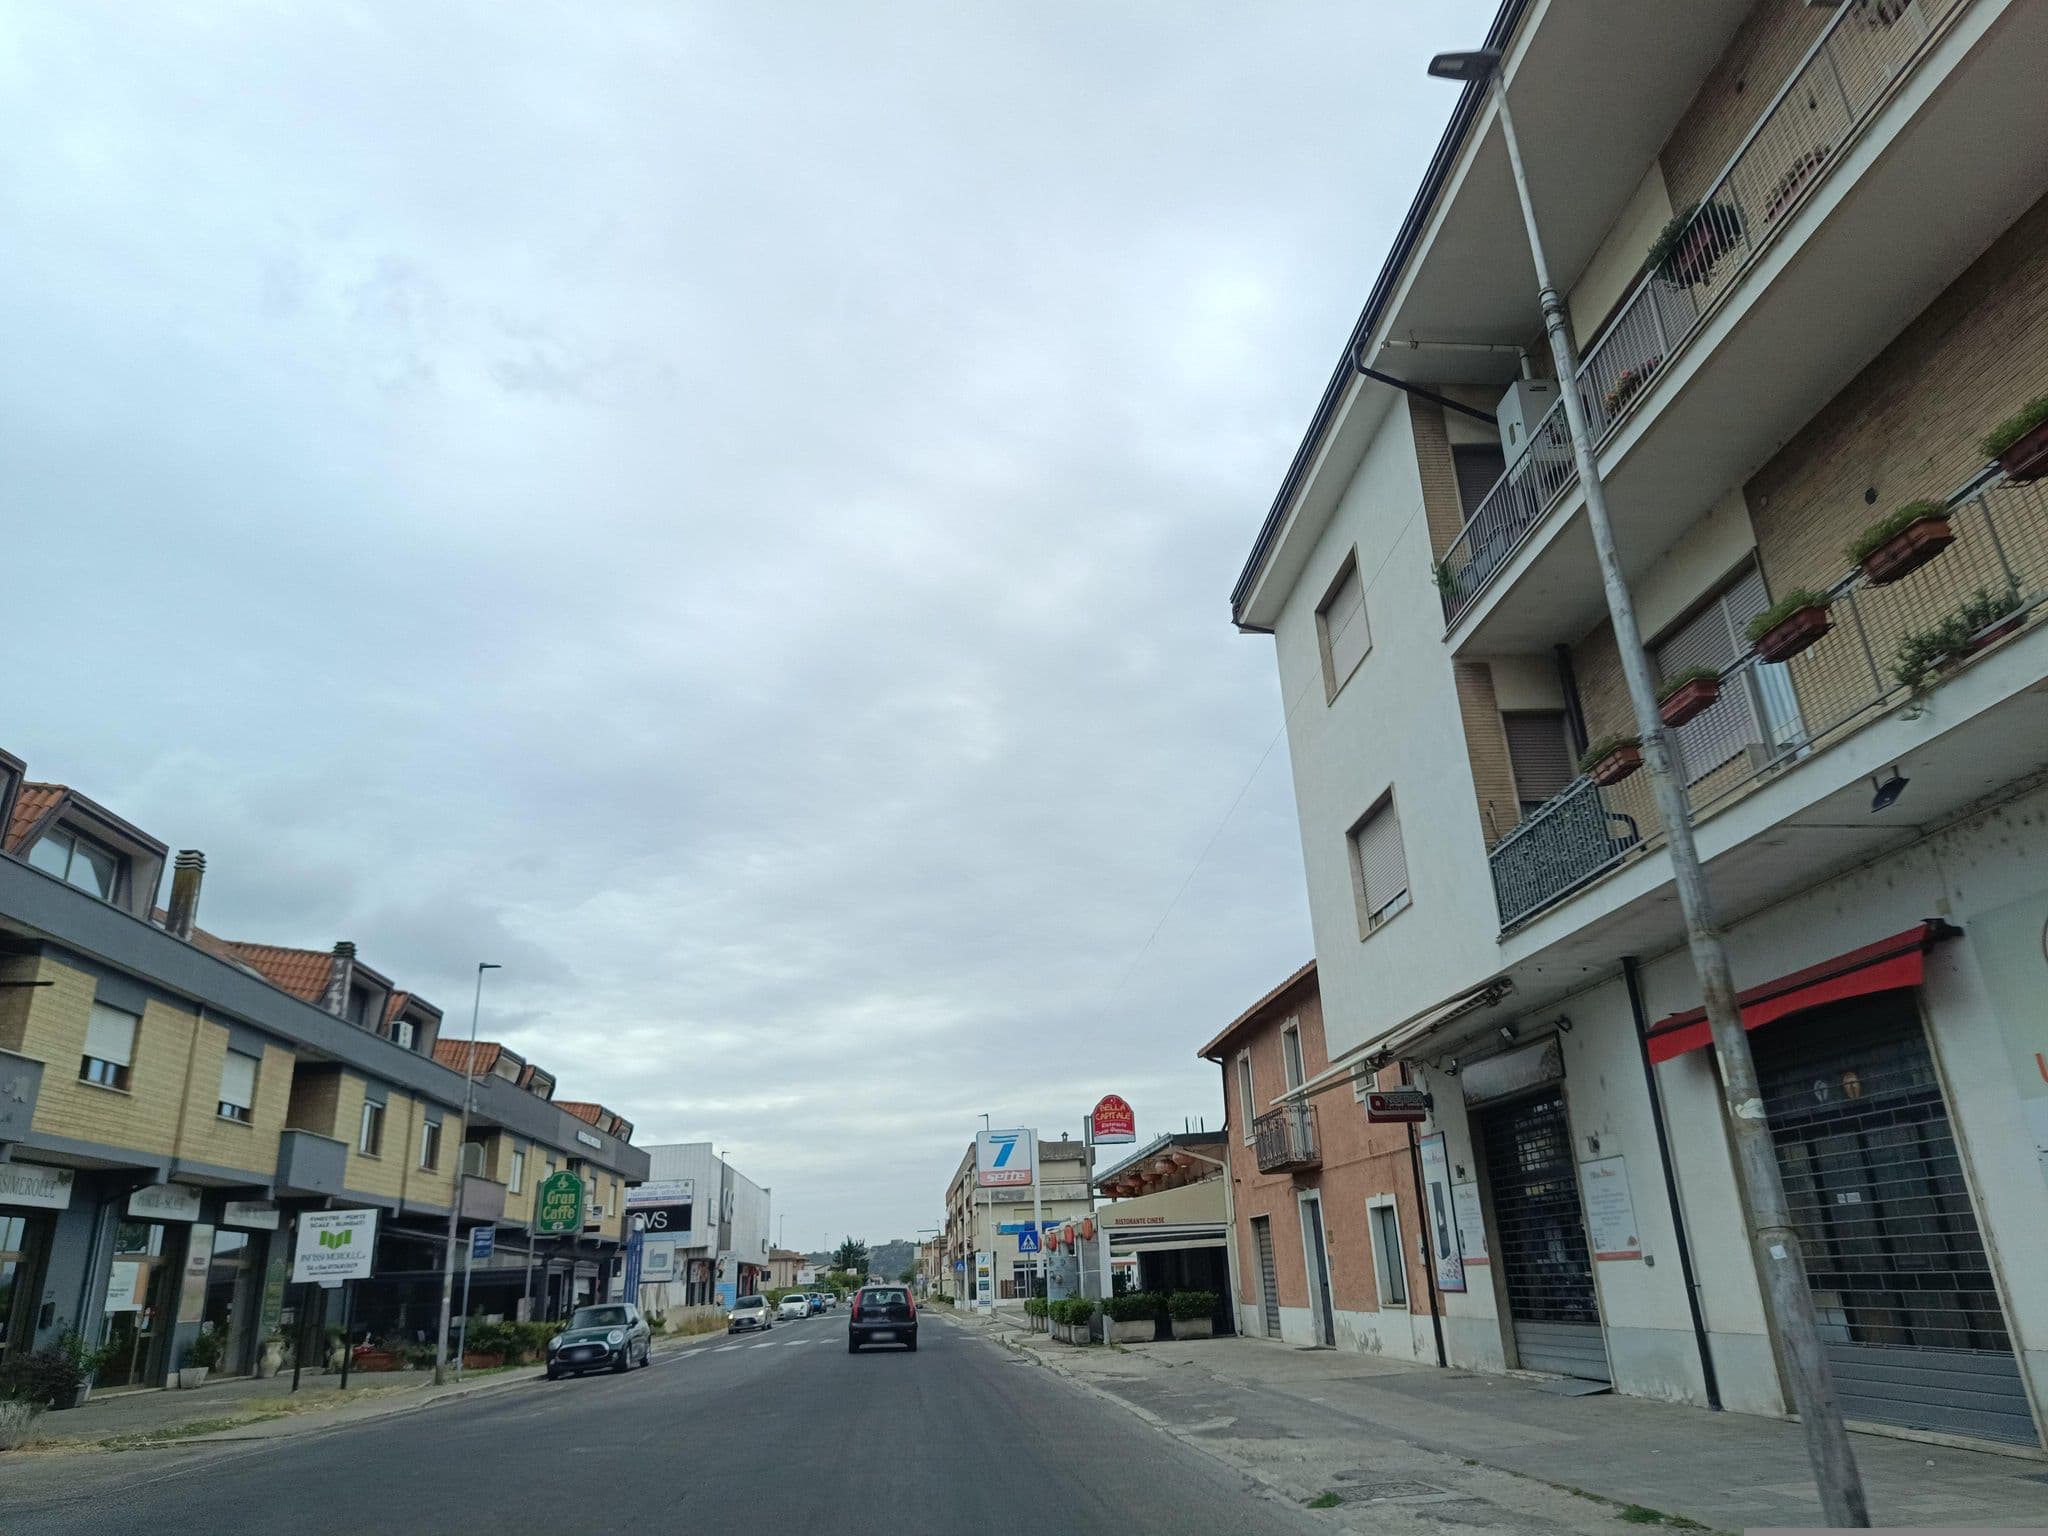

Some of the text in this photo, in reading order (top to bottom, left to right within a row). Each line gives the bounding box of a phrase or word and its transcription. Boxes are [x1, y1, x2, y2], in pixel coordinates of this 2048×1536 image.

[1095, 1111, 1130, 1120] CAPITALE
[989, 1134, 1020, 1168] 7
[986, 1171, 1026, 1182] sette
[547, 1191, 576, 1204] Gran
[1115, 1216, 1165, 1225] RISTORANTE CINESE
